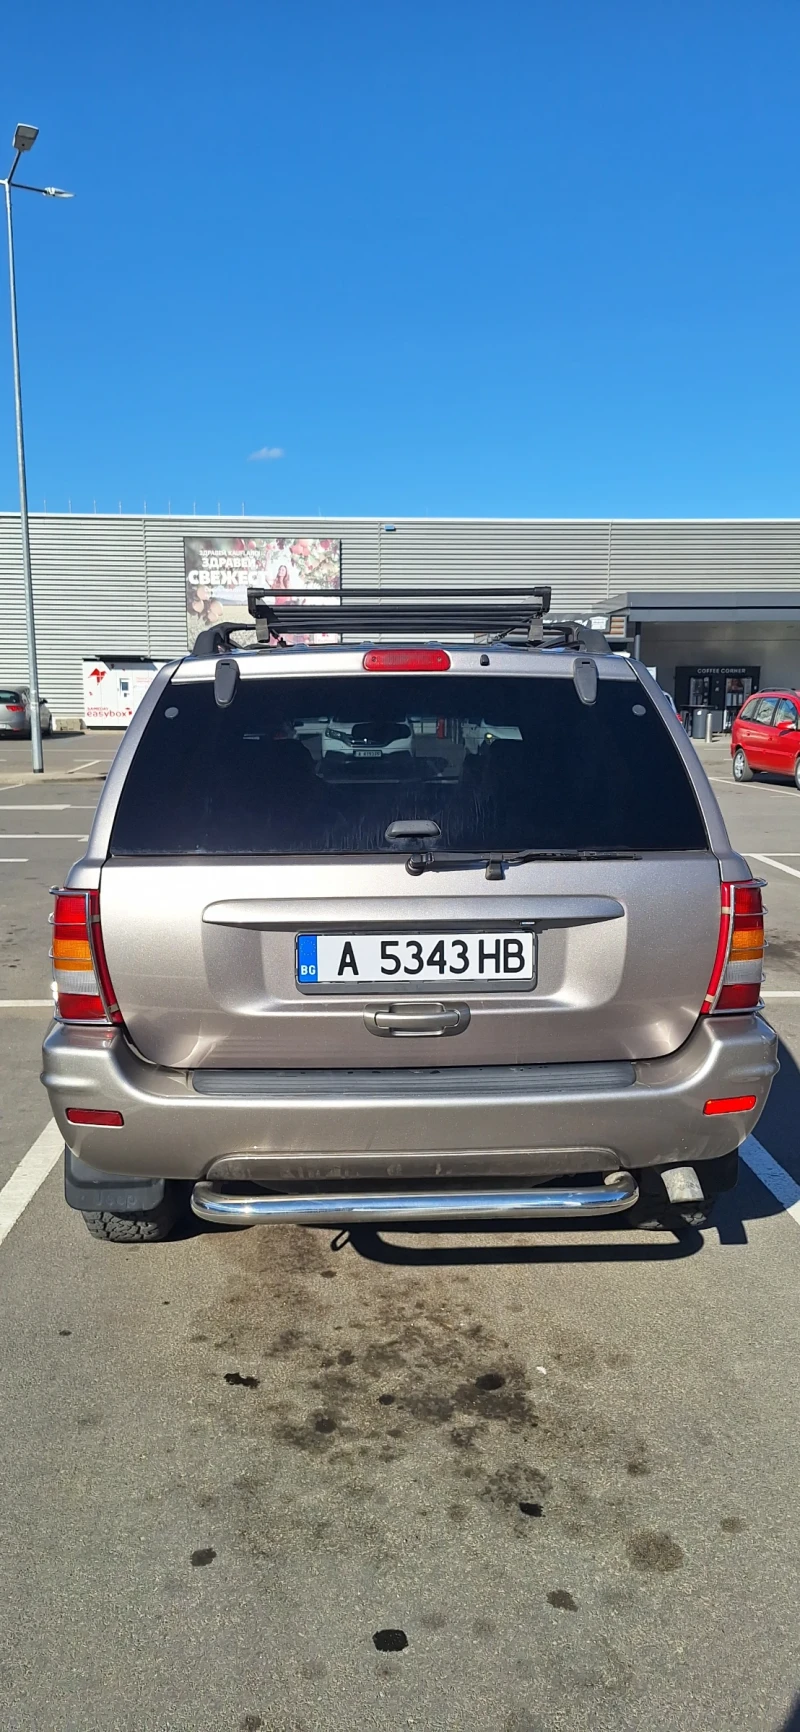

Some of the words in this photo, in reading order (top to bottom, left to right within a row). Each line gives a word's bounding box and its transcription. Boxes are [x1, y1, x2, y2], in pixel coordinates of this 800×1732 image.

[86, 710, 127, 718] easybox
[337, 941, 359, 976] A
[380, 939, 470, 975] 5343
[478, 938, 525, 974] HB
[300, 964, 316, 976] BG
[96, 1189, 137, 1208] Jeep
